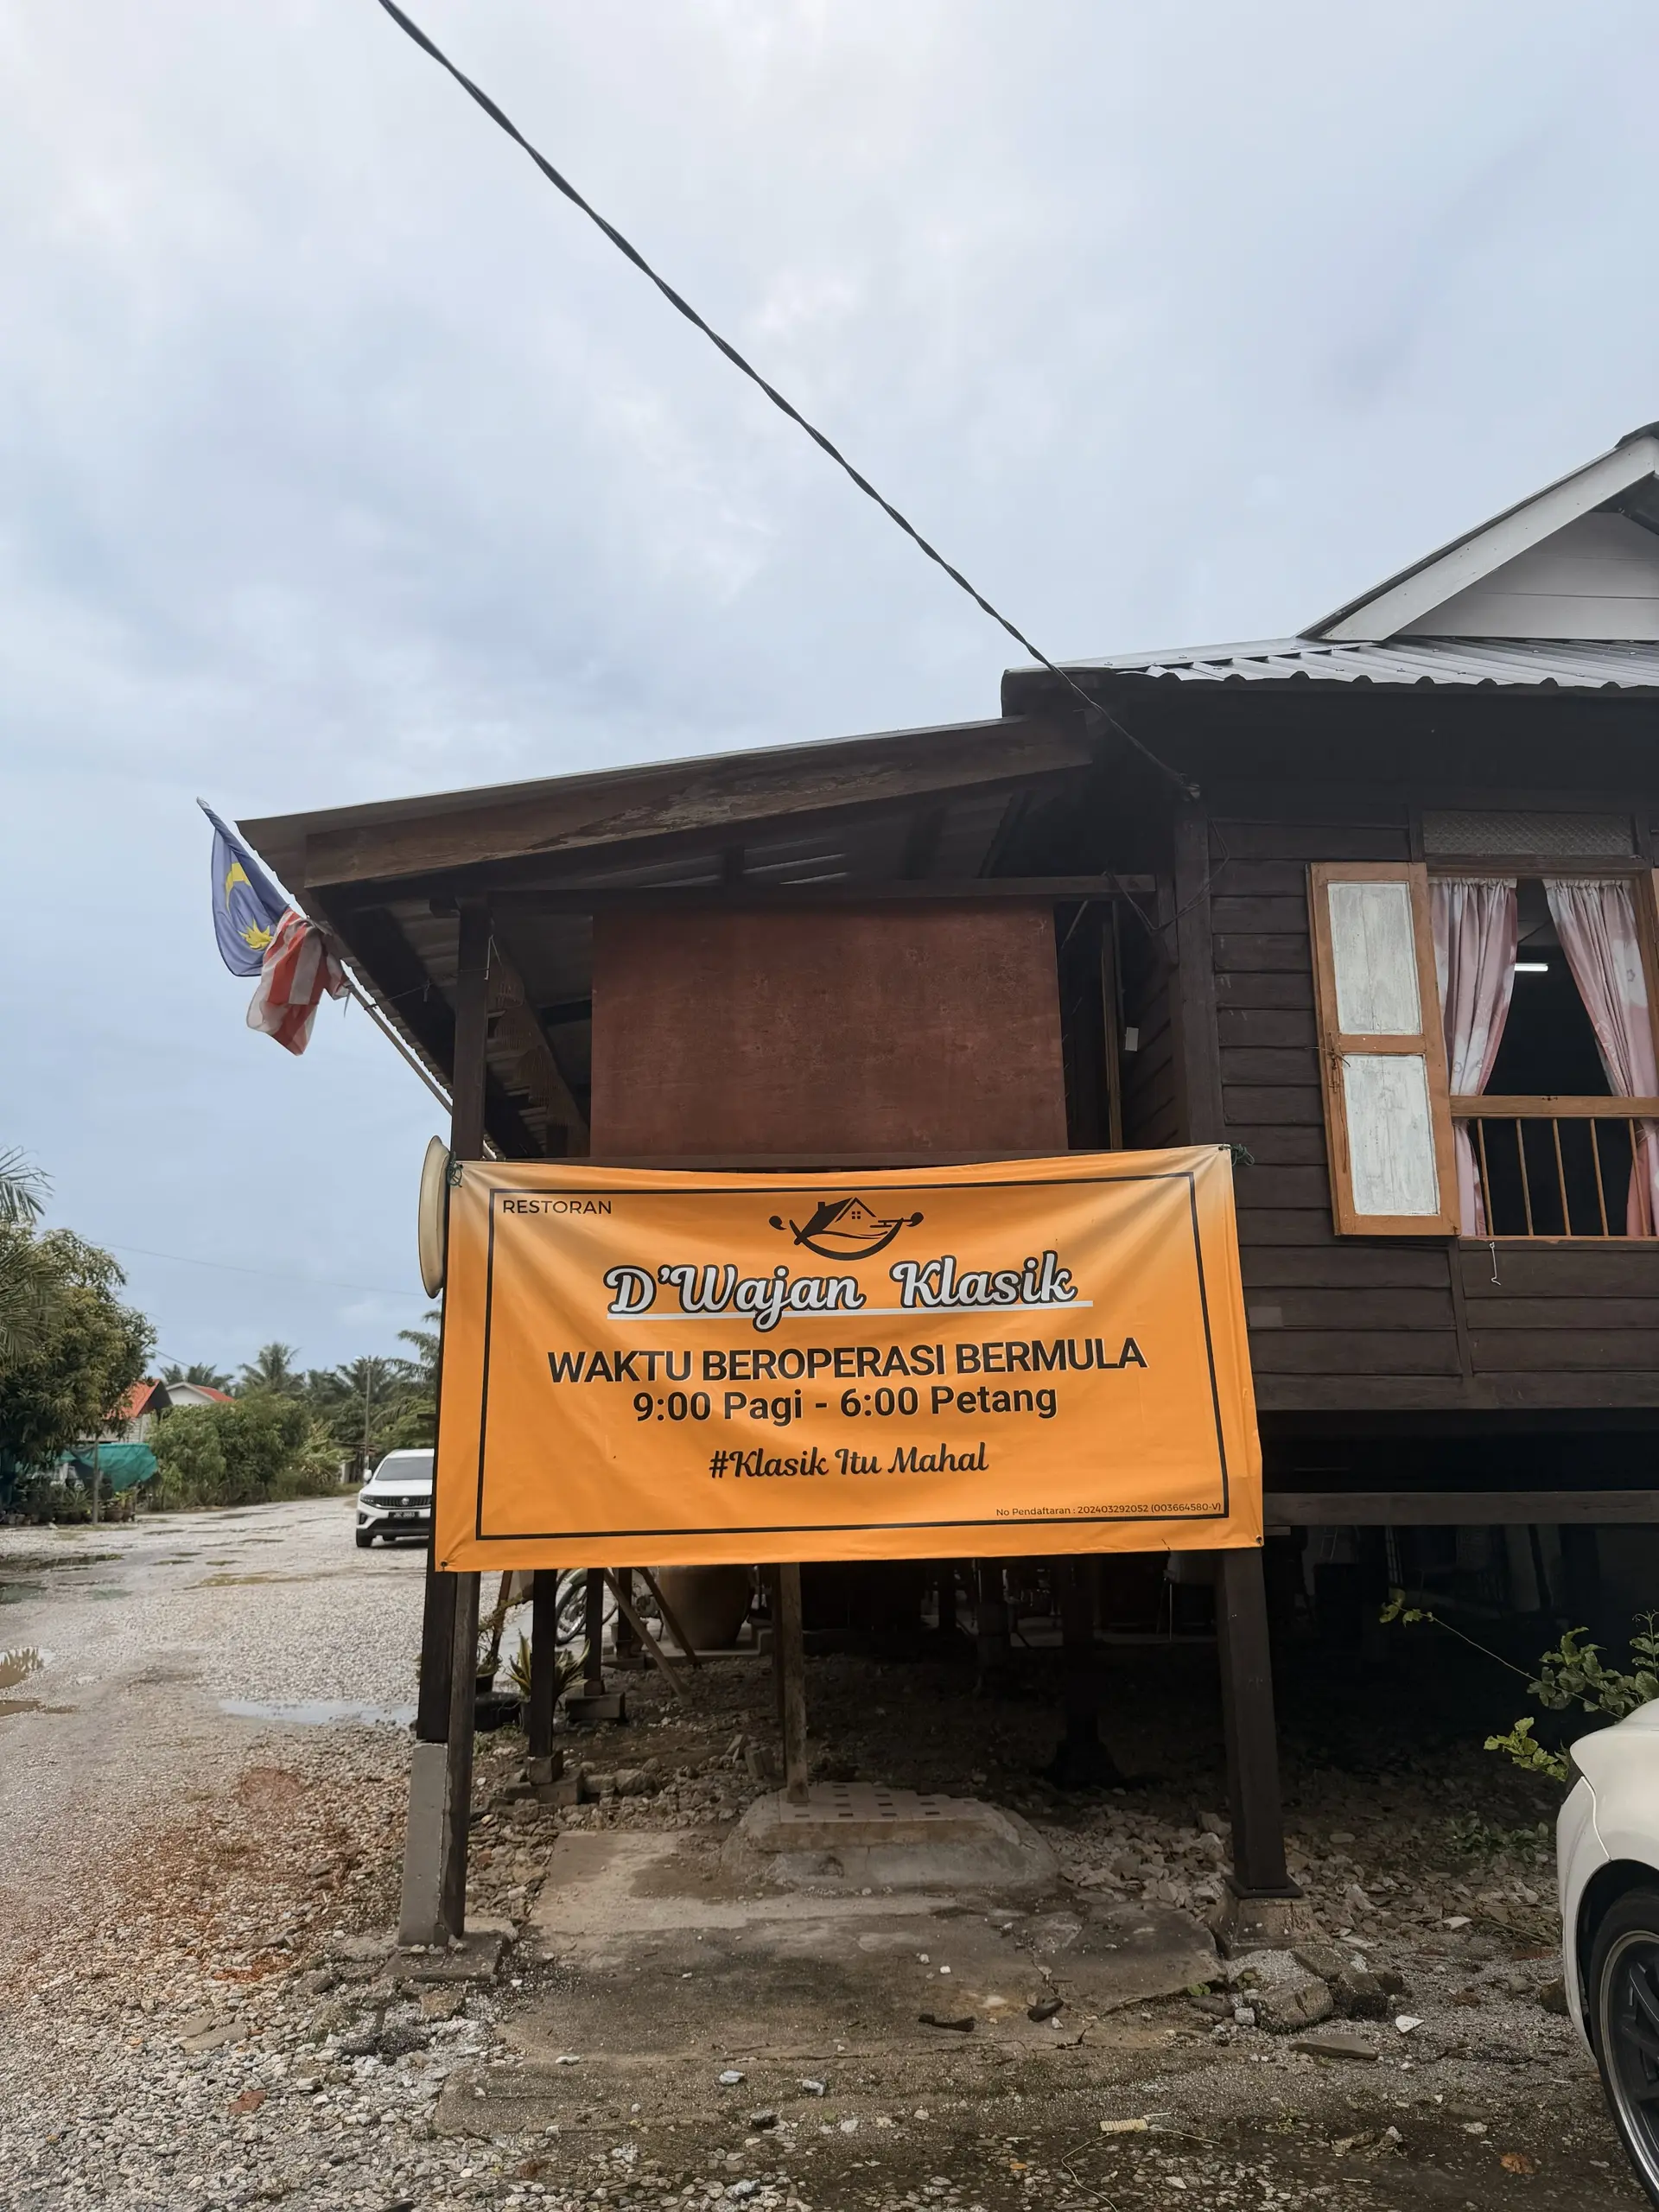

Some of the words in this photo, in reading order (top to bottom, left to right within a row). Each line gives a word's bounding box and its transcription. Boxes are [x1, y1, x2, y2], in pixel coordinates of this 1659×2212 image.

[503, 1199, 612, 1215] RESTORAN
[889, 1249, 1078, 1309] Klasik
[548, 1351, 692, 1383] WAKTU
[702, 1344, 945, 1381] BEROPERASI
[956, 1337, 1147, 1375] BERMULA
[633, 1391, 712, 1422] 9:00
[724, 1389, 803, 1427] Pagi
[840, 1386, 918, 1418] 6:00
[931, 1384, 1058, 1419] Petang
[709, 1446, 830, 1478] #Klasik
[835, 1446, 882, 1475] Itu
[887, 1441, 989, 1474] Mahal
[1012, 1506, 1071, 1516] Pendaftaran
[1077, 1504, 1149, 1514] 202403292052
[1150, 1502, 1222, 1513] (003664580-V)
